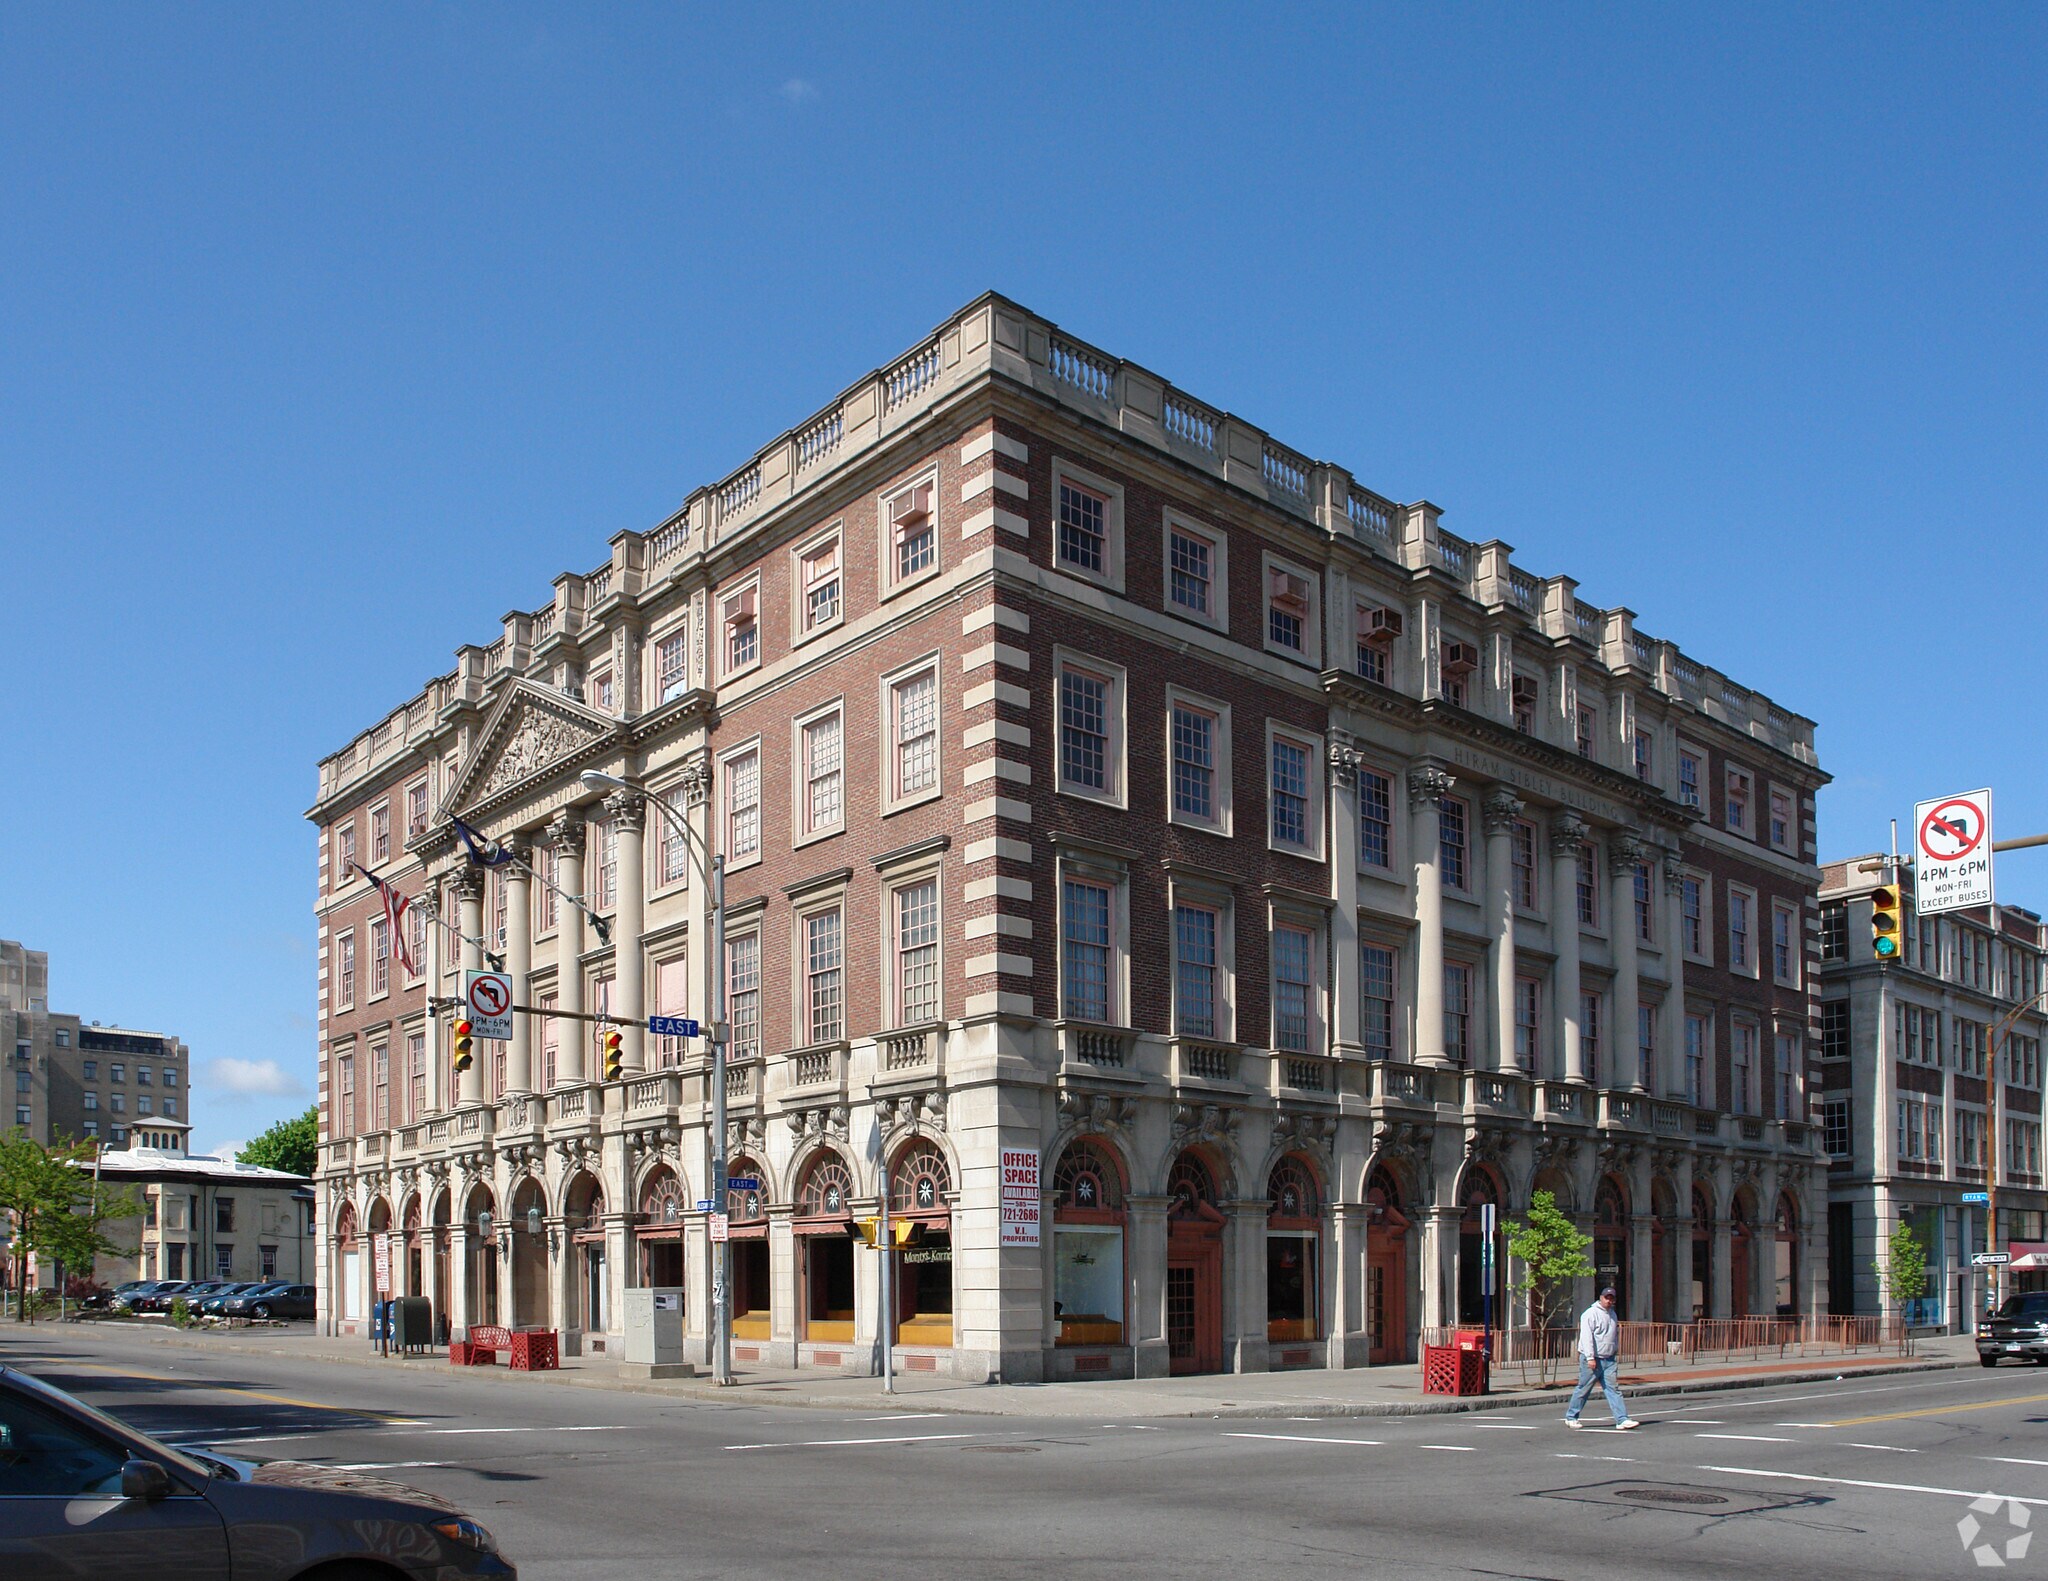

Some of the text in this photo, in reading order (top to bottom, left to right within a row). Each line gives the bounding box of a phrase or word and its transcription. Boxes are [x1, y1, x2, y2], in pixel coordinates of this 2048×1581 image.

[1454, 747, 1619, 820] HIRAM SIBLEY BUILDING
[1935, 880, 1972, 893] MON-FRI
[1921, 890, 1988, 908] EXCEPT BUSES
[477, 1027, 503, 1035] MON-FRI
[656, 1019, 692, 1035] EAST
[1003, 1152, 1038, 1168] OFFICE
[1004, 1169, 1038, 1184] SPACE
[731, 1180, 748, 1188] EAST
[1003, 1187, 1038, 1199] AVAILABLE
[1003, 1208, 1038, 1221] 721-2686
[1014, 1226, 1027, 1235] V.I.
[1002, 1235, 1038, 1243] PROPERTIES
